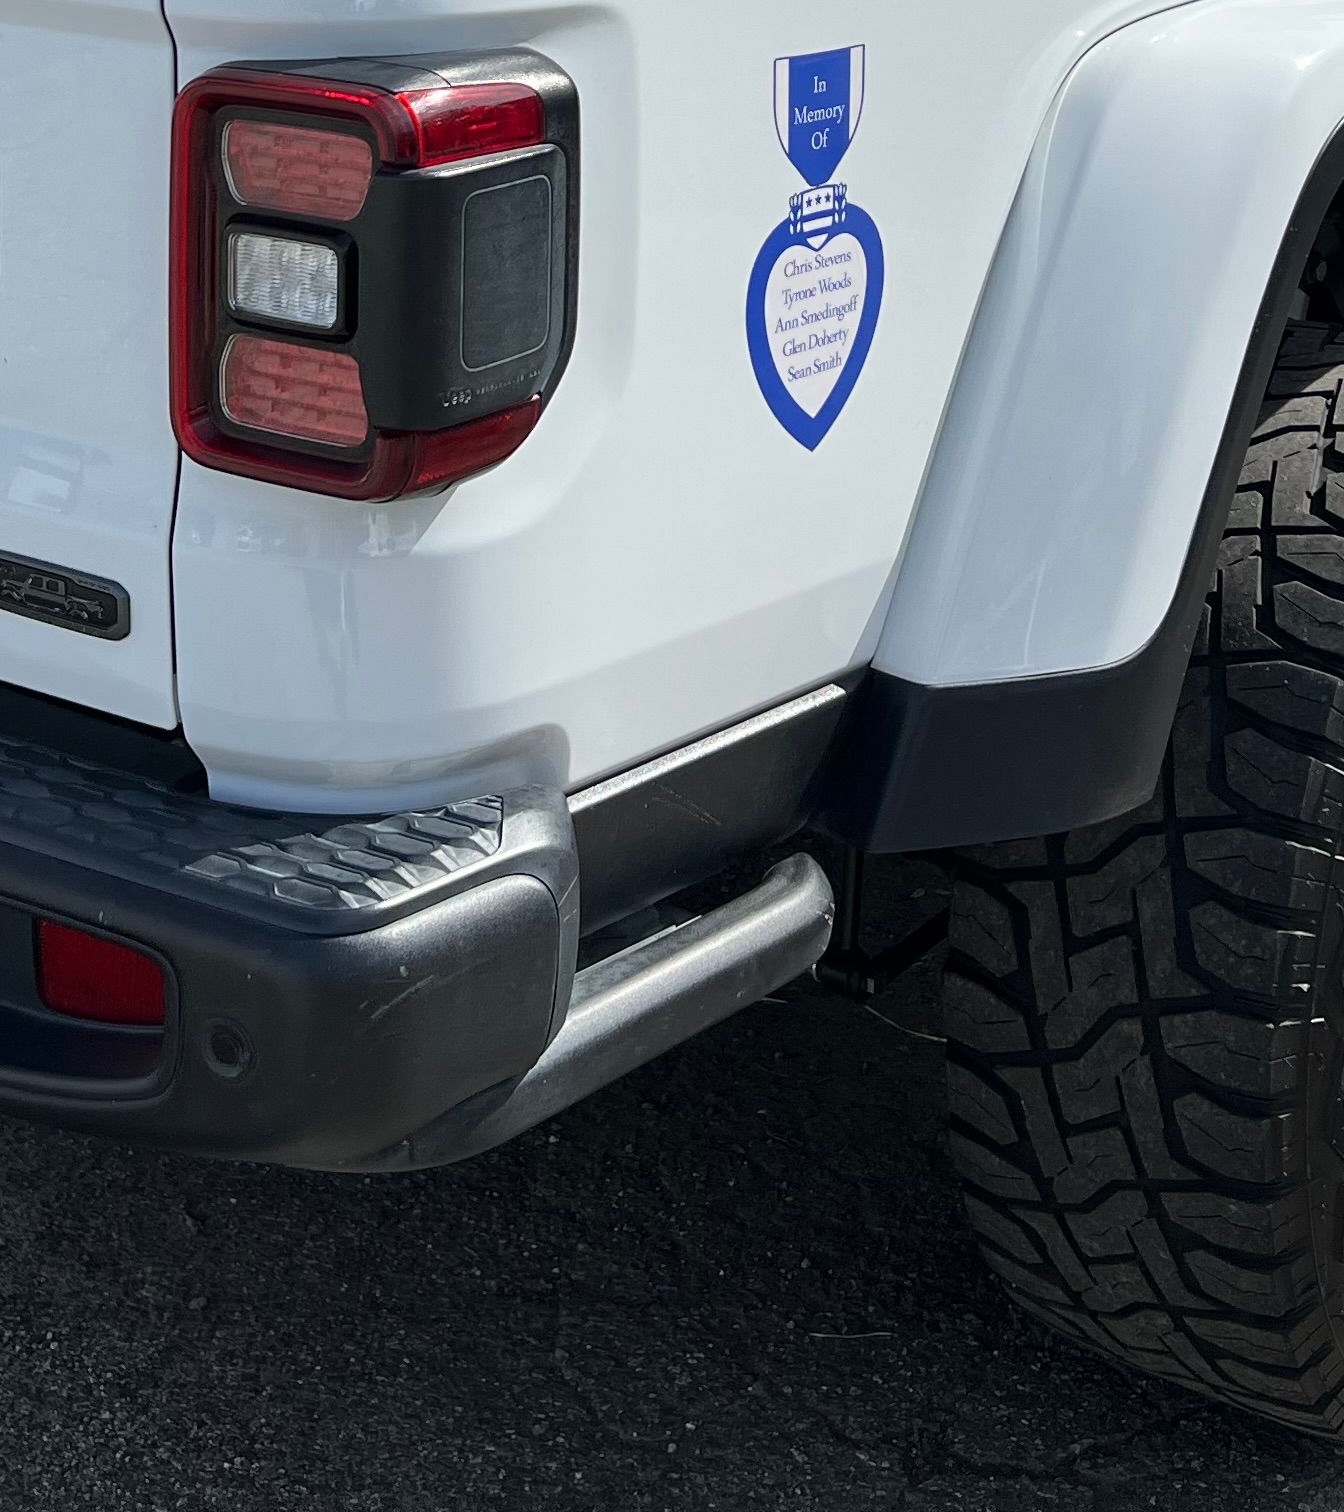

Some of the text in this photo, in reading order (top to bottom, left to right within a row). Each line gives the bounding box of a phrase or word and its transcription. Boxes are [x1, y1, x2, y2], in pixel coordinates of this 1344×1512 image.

[813, 75, 827, 93] In
[793, 104, 846, 125] Memory
[811, 128, 830, 149] Of
[783, 251, 852, 278] Chris Stevens
[782, 272, 852, 309] Tyrone Woods
[774, 317, 798, 334] Ann
[782, 328, 850, 357] Glen Doherty
[787, 350, 843, 383] Sean Smith
